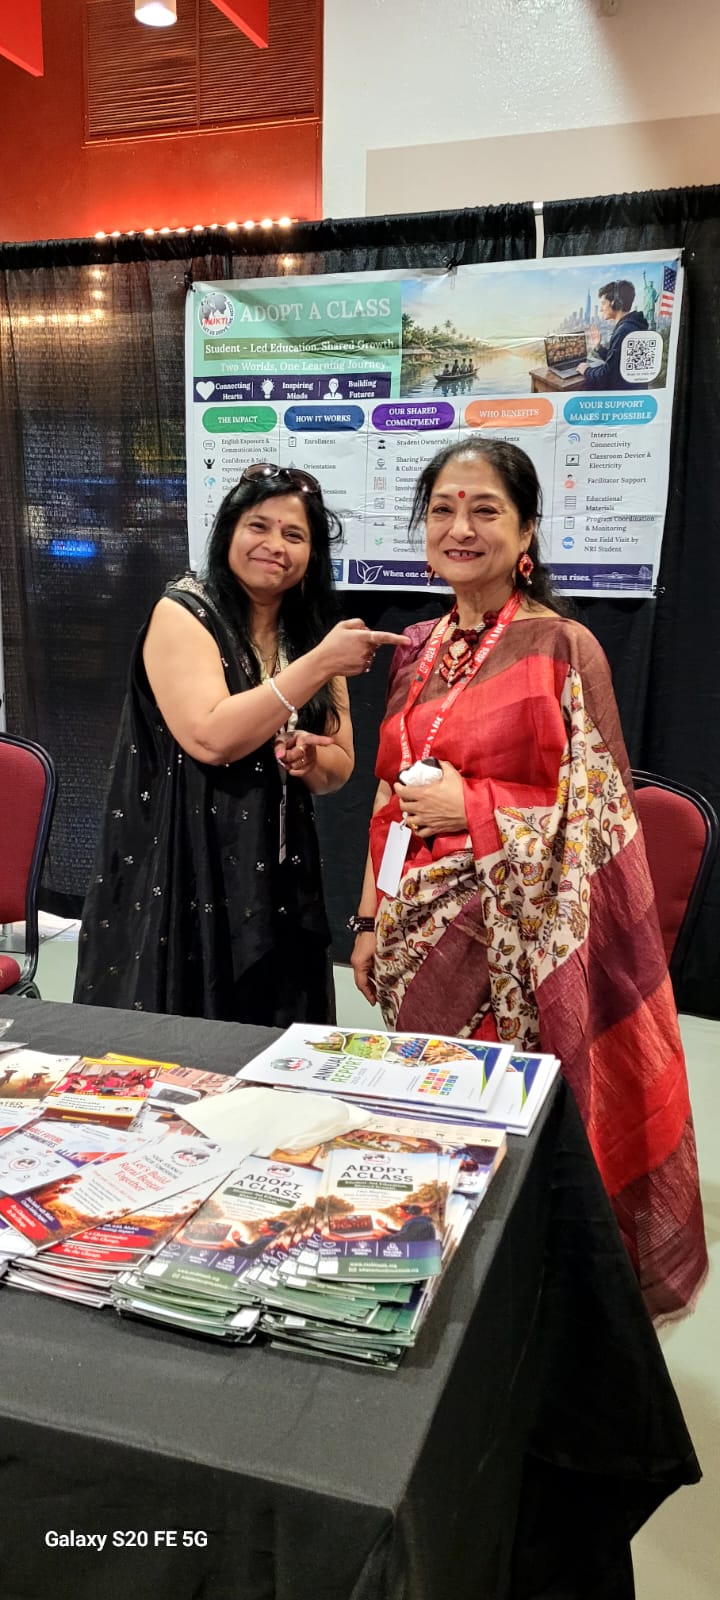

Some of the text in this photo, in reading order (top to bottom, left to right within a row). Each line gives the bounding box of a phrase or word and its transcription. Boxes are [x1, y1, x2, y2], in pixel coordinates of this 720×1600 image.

[240, 298, 391, 322] ADOPT A CLASS
[202, 317, 229, 326] MUKTI
[205, 343, 241, 354] Student
[250, 343, 268, 353] Led
[321, 340, 355, 350] Shared
[221, 363, 239, 372] Two
[241, 361, 278, 373] Worlds,
[280, 361, 299, 371] One
[302, 361, 345, 372] Learning
[215, 382, 251, 391] Connecting
[282, 382, 314, 391] Inspiring
[348, 380, 377, 388] Building
[287, 392, 308, 400] Minds
[349, 391, 375, 399] Futures
[579, 400, 645, 409] YOUR SUPPORT
[406, 407, 437, 415] SHARED
[480, 409, 540, 418] WHO BENEFITS
[296, 415, 314, 423] HOW
[324, 414, 352, 422] WORKS
[569, 412, 652, 421] MAKES IT POSSIBLE
[385, 418, 441, 427] COMMITMENT
[631, 536, 639, 544] by
[383, 570, 404, 578] When
[569, 573, 592, 581] rises.
[312, 1056, 347, 1081] ANNUAL
[330, 1056, 365, 1084] REPORT
[346, 1164, 408, 1175] ADOPT
[357, 1172, 414, 1183] CLASS
[243, 1174, 304, 1191] ADOPT
[248, 1182, 303, 1200] CLASS
